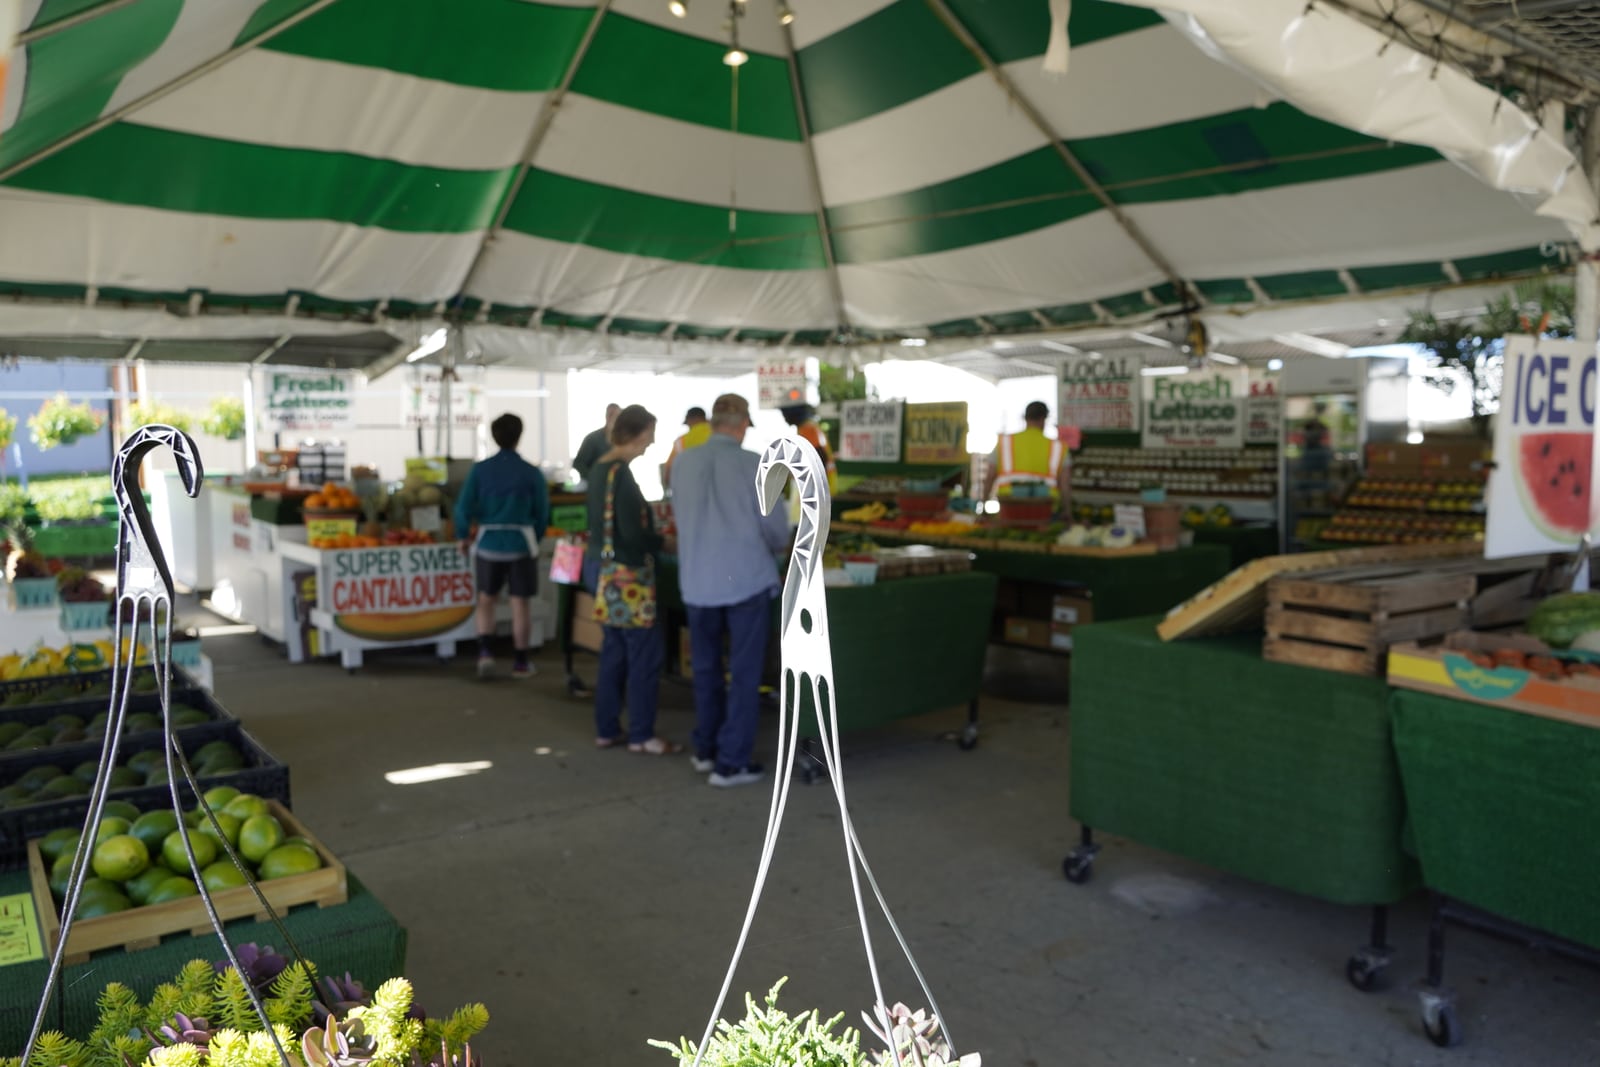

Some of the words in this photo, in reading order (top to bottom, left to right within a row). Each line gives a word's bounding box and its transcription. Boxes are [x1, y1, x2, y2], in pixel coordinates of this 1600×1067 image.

[273, 372, 344, 392] Fresh
[1062, 357, 1133, 382] LOCAL
[1153, 374, 1232, 401] Fresh
[1513, 353, 1569, 425] ICE
[268, 393, 349, 409] Lettuce
[1149, 401, 1236, 420] Lettuce
[335, 549, 403, 577] SUPER
[332, 572, 474, 612] CANTALOUPES
